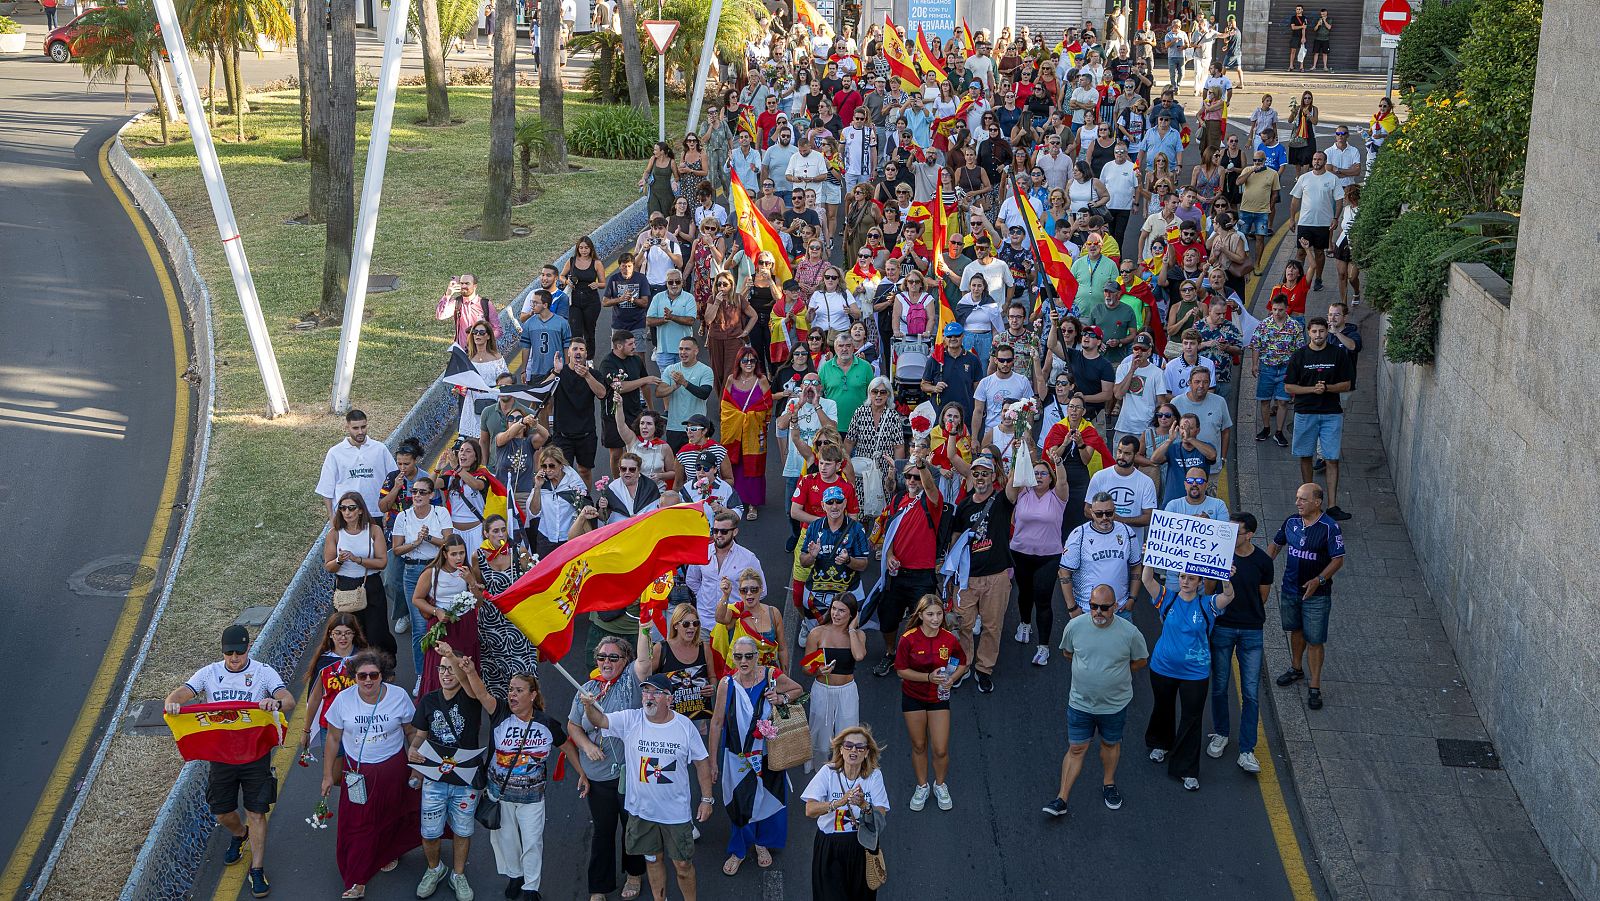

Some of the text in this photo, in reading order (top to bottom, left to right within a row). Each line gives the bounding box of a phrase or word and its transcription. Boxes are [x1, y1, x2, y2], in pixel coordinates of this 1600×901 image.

[540, 332, 550, 355] 3
[1152, 513, 1215, 536] NUESTROS
[1210, 542, 1219, 552] Y
[1092, 550, 1125, 561] CEUTA
[1194, 553, 1227, 568] ESTÁN
[213, 690, 253, 702] CEUTA
[674, 688, 692, 698] CEUTA
[373, 725, 384, 733] MY
[505, 727, 543, 739] CEUTA
[501, 737, 548, 747] NO SE RINDE
